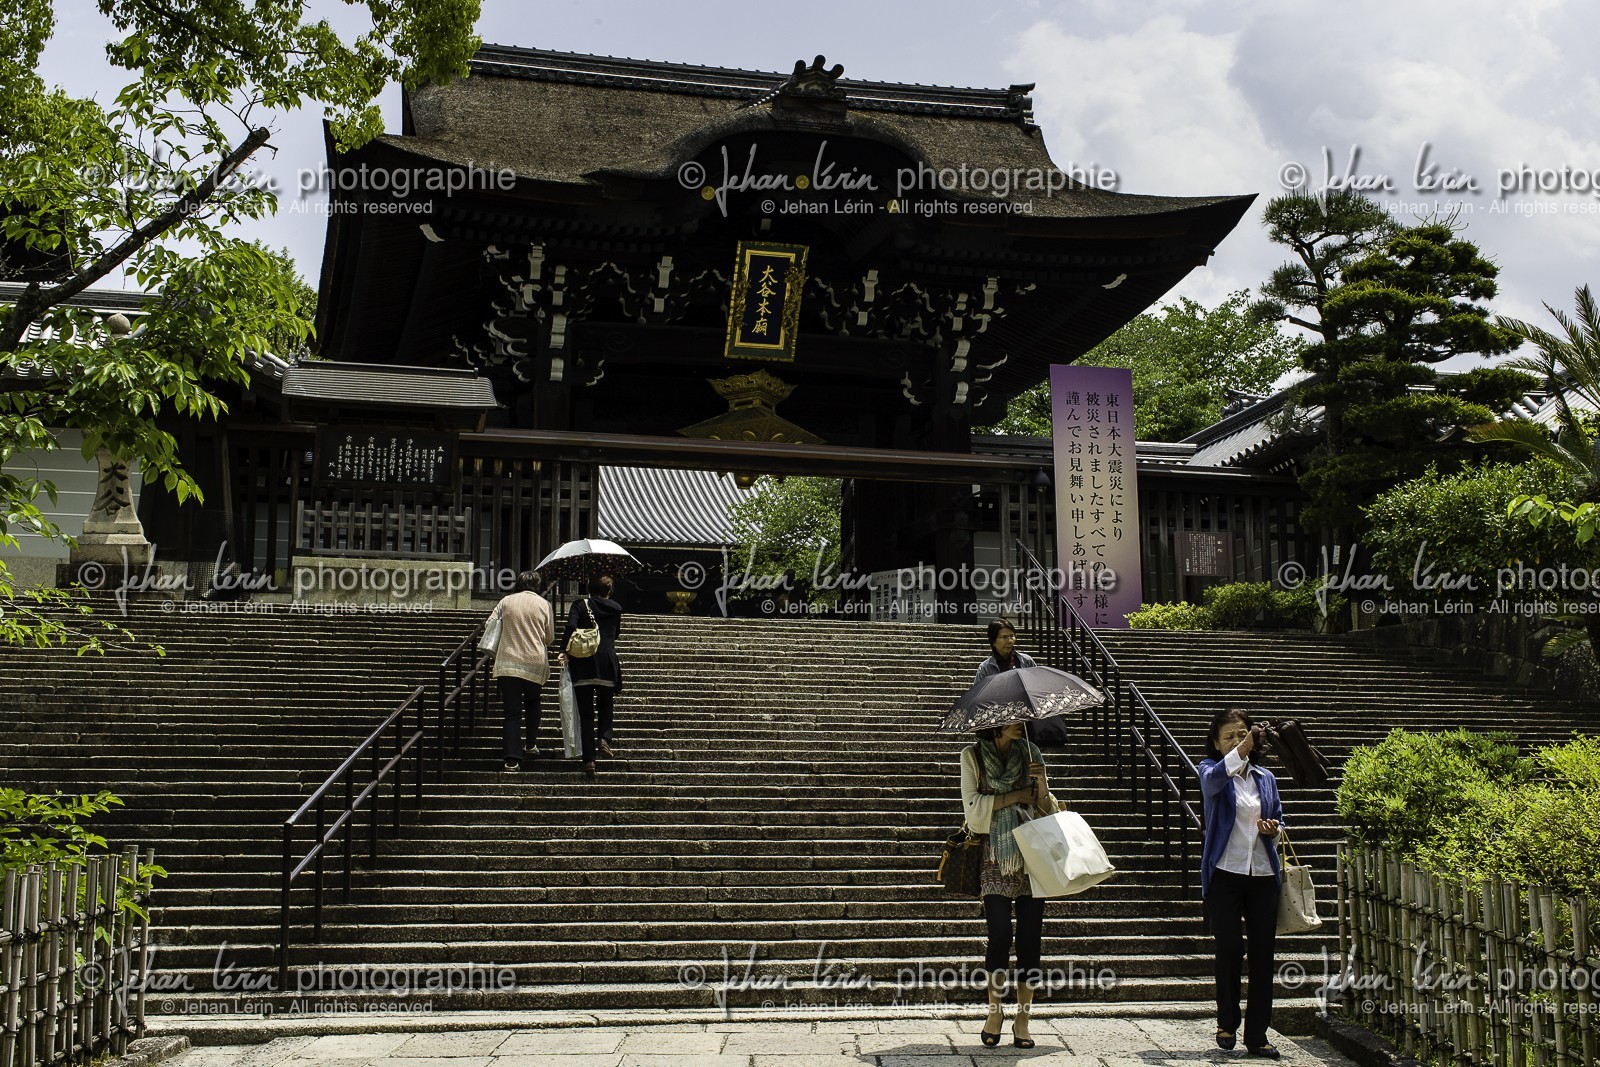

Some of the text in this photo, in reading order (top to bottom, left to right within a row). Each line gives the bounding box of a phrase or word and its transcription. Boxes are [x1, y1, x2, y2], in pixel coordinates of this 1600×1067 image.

[752, 265, 778, 336] 大谷本廟
[1105, 393, 1124, 541] 東日本大震災により
